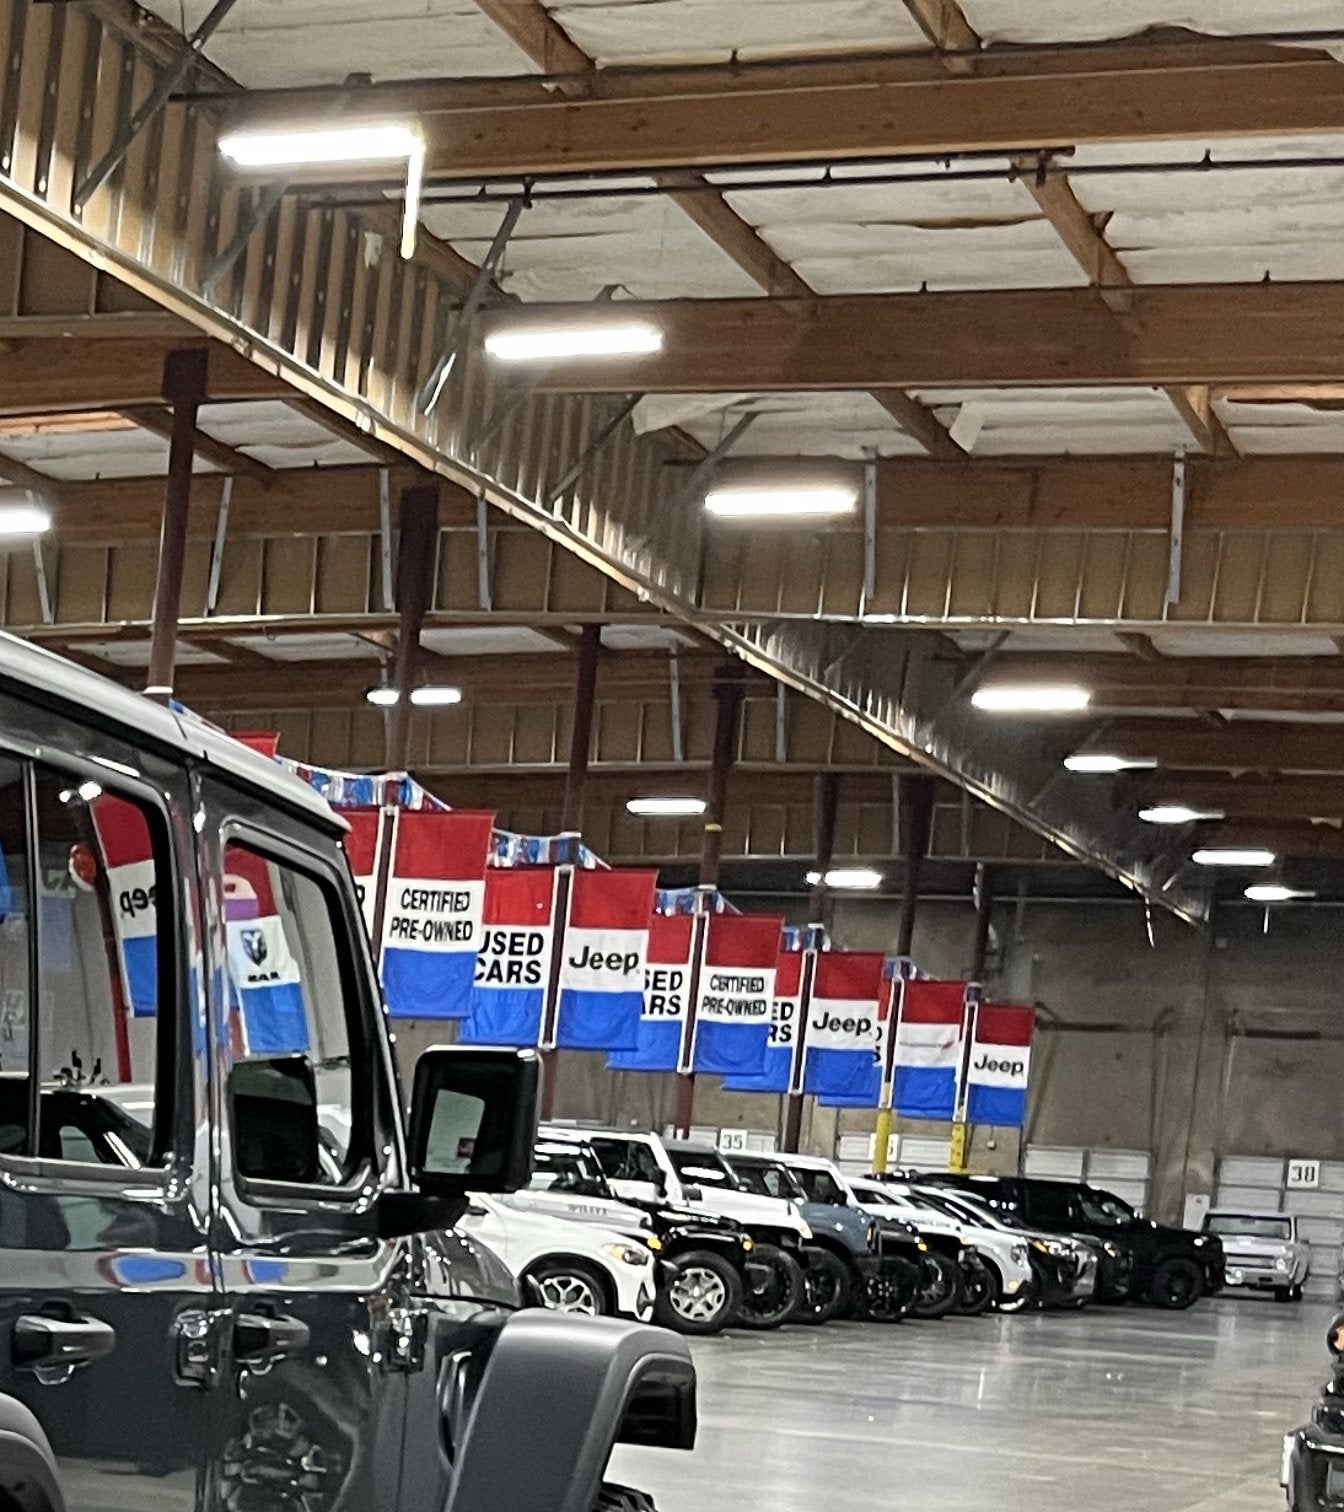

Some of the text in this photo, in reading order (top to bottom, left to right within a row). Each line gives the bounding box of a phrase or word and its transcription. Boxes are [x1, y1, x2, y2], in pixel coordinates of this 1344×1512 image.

[401, 888, 471, 912] CERTIFIED
[390, 917, 473, 941] PRE-OWNED
[569, 946, 639, 975] Jeep
[710, 974, 765, 993] CERTIFIED
[701, 996, 767, 1016] PRE-OWNED
[813, 1012, 871, 1036] Jeep
[974, 1055, 1024, 1077] Jeep
[722, 1134, 743, 1150] 35
